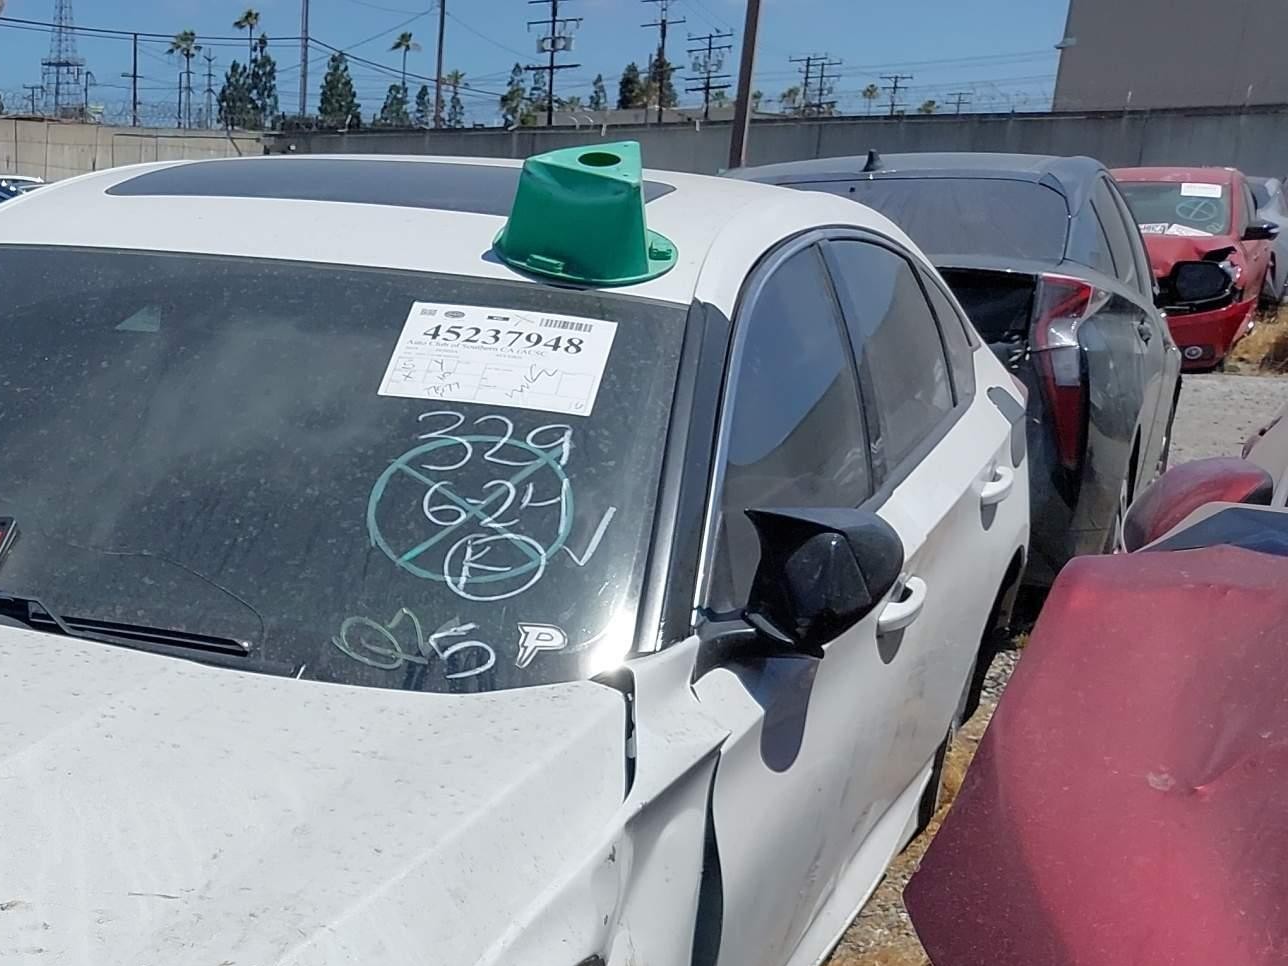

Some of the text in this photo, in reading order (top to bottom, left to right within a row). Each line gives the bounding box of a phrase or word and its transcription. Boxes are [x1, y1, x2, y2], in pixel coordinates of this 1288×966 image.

[423, 324, 585, 355] 45237948
[429, 339, 450, 348] Club
[462, 343, 498, 352] Southern
[418, 410, 573, 471] 329
